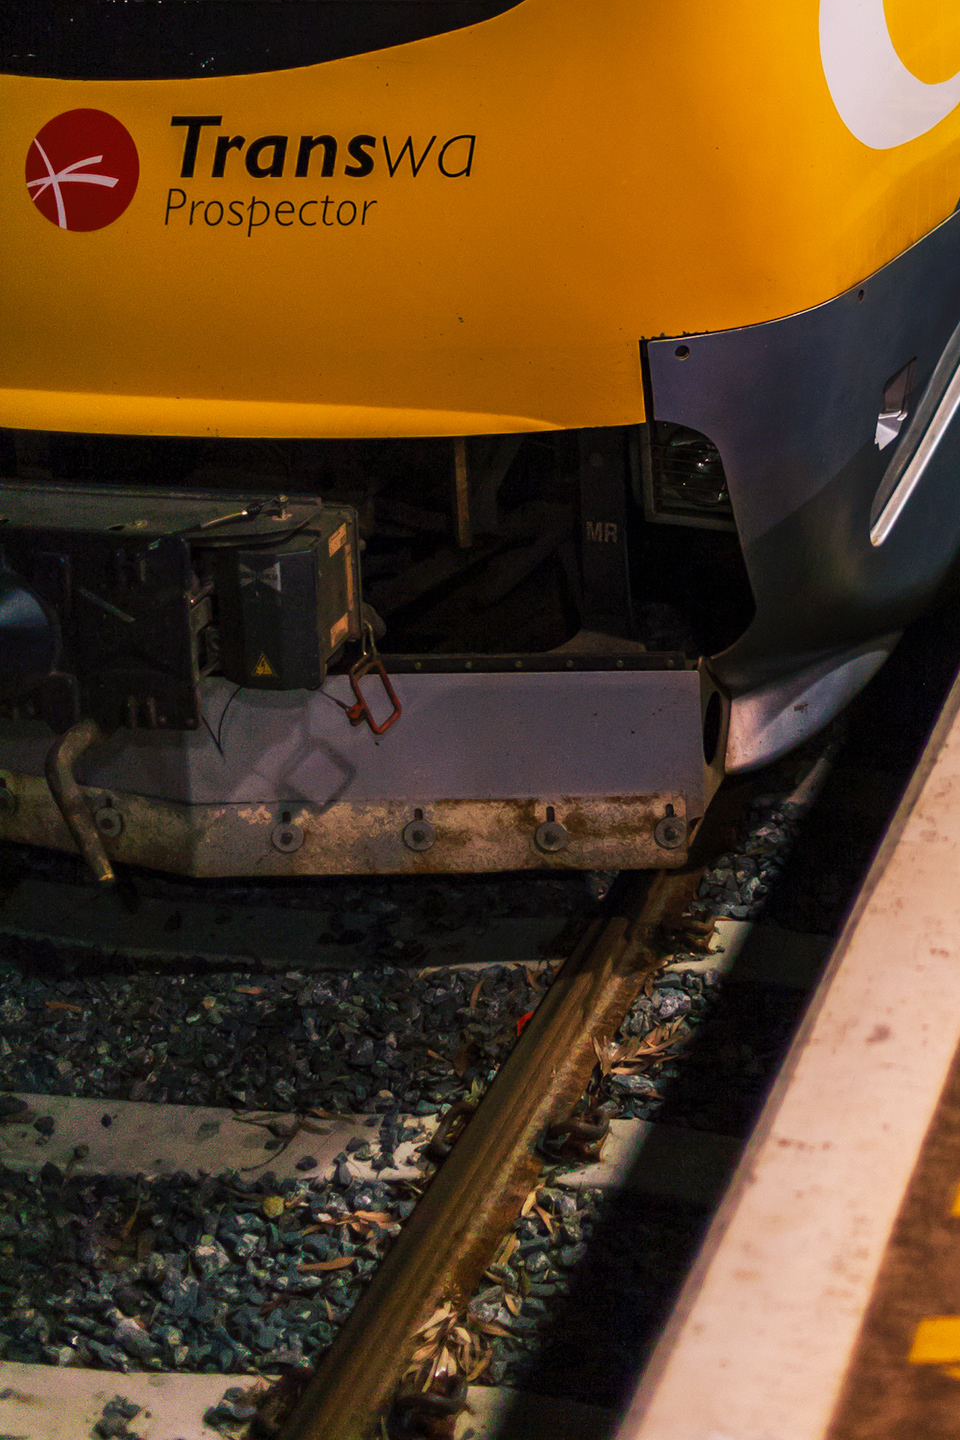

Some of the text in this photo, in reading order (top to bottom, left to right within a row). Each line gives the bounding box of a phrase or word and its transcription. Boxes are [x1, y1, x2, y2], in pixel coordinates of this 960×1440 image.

[170, 115, 478, 179] Transwa
[164, 188, 378, 238] Prospector
[585, 521, 618, 543] MR
